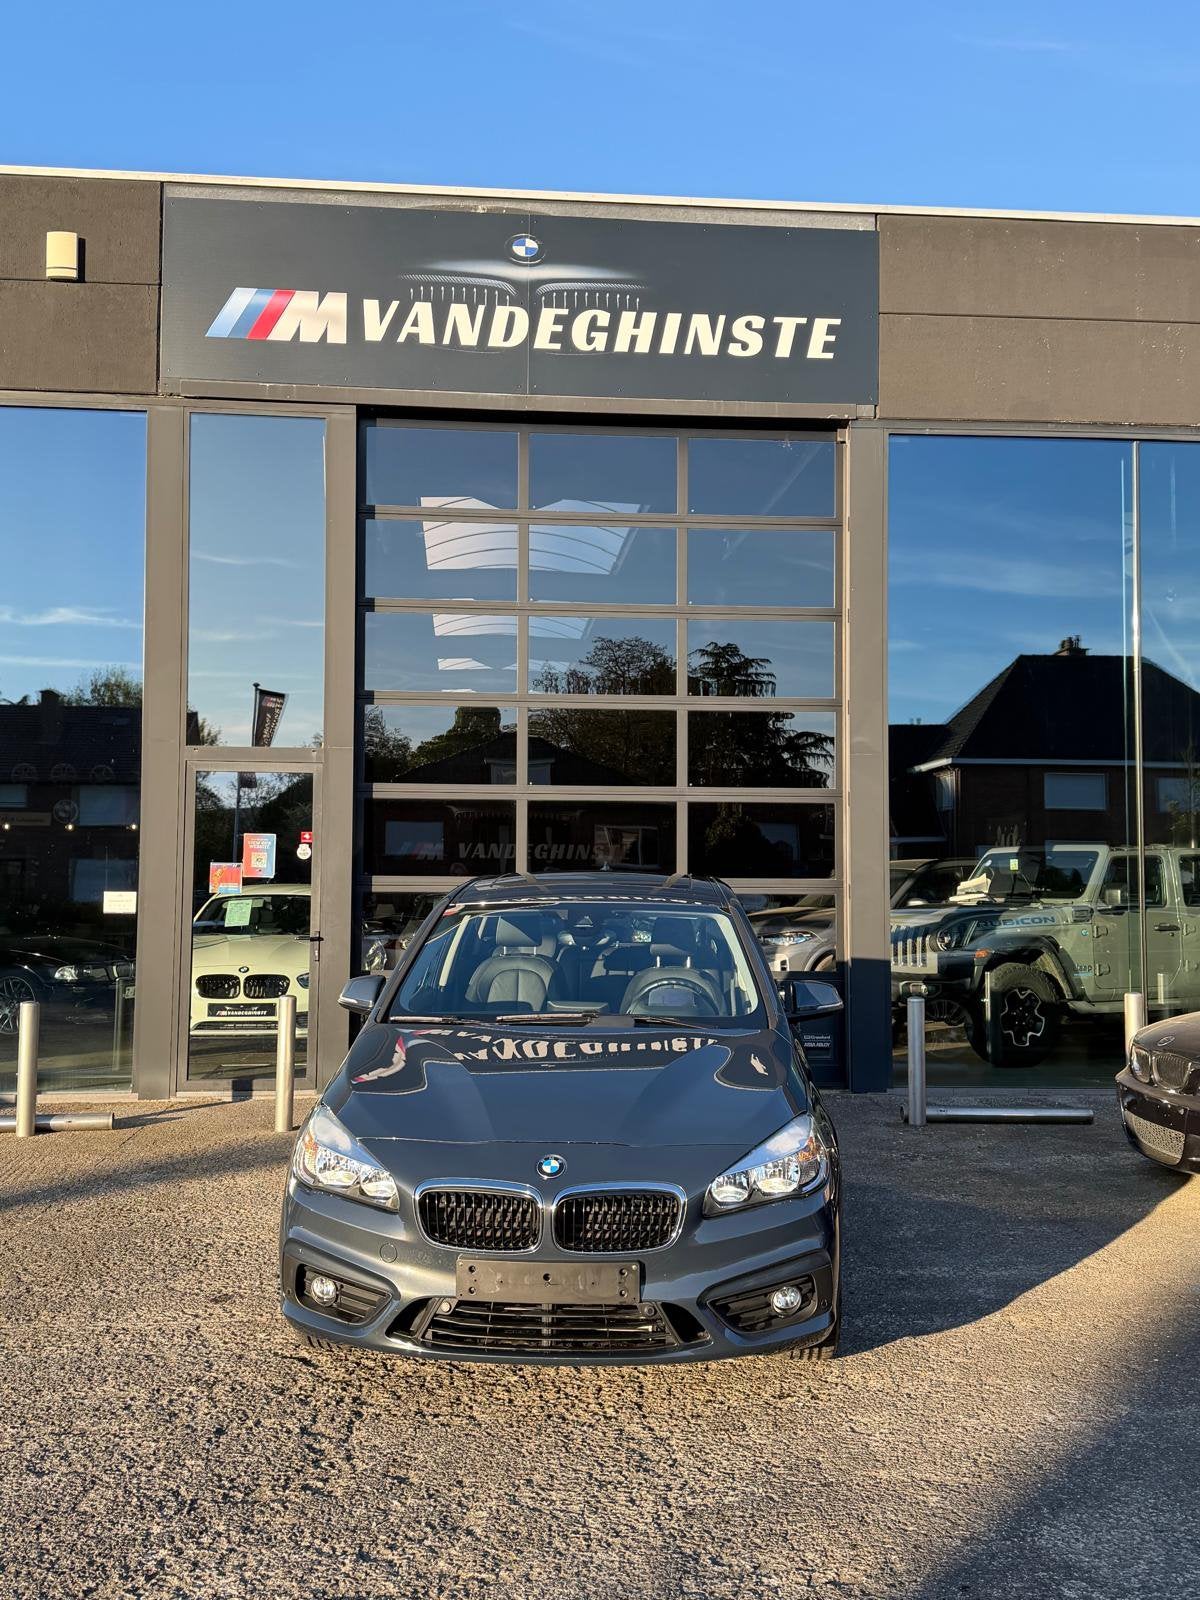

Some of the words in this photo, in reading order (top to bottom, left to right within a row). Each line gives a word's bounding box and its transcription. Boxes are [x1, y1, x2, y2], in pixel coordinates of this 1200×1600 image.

[264, 289, 348, 344] M
[362, 299, 842, 360] VANDEGHINSTE
[977, 915, 1055, 927] RUBICON
